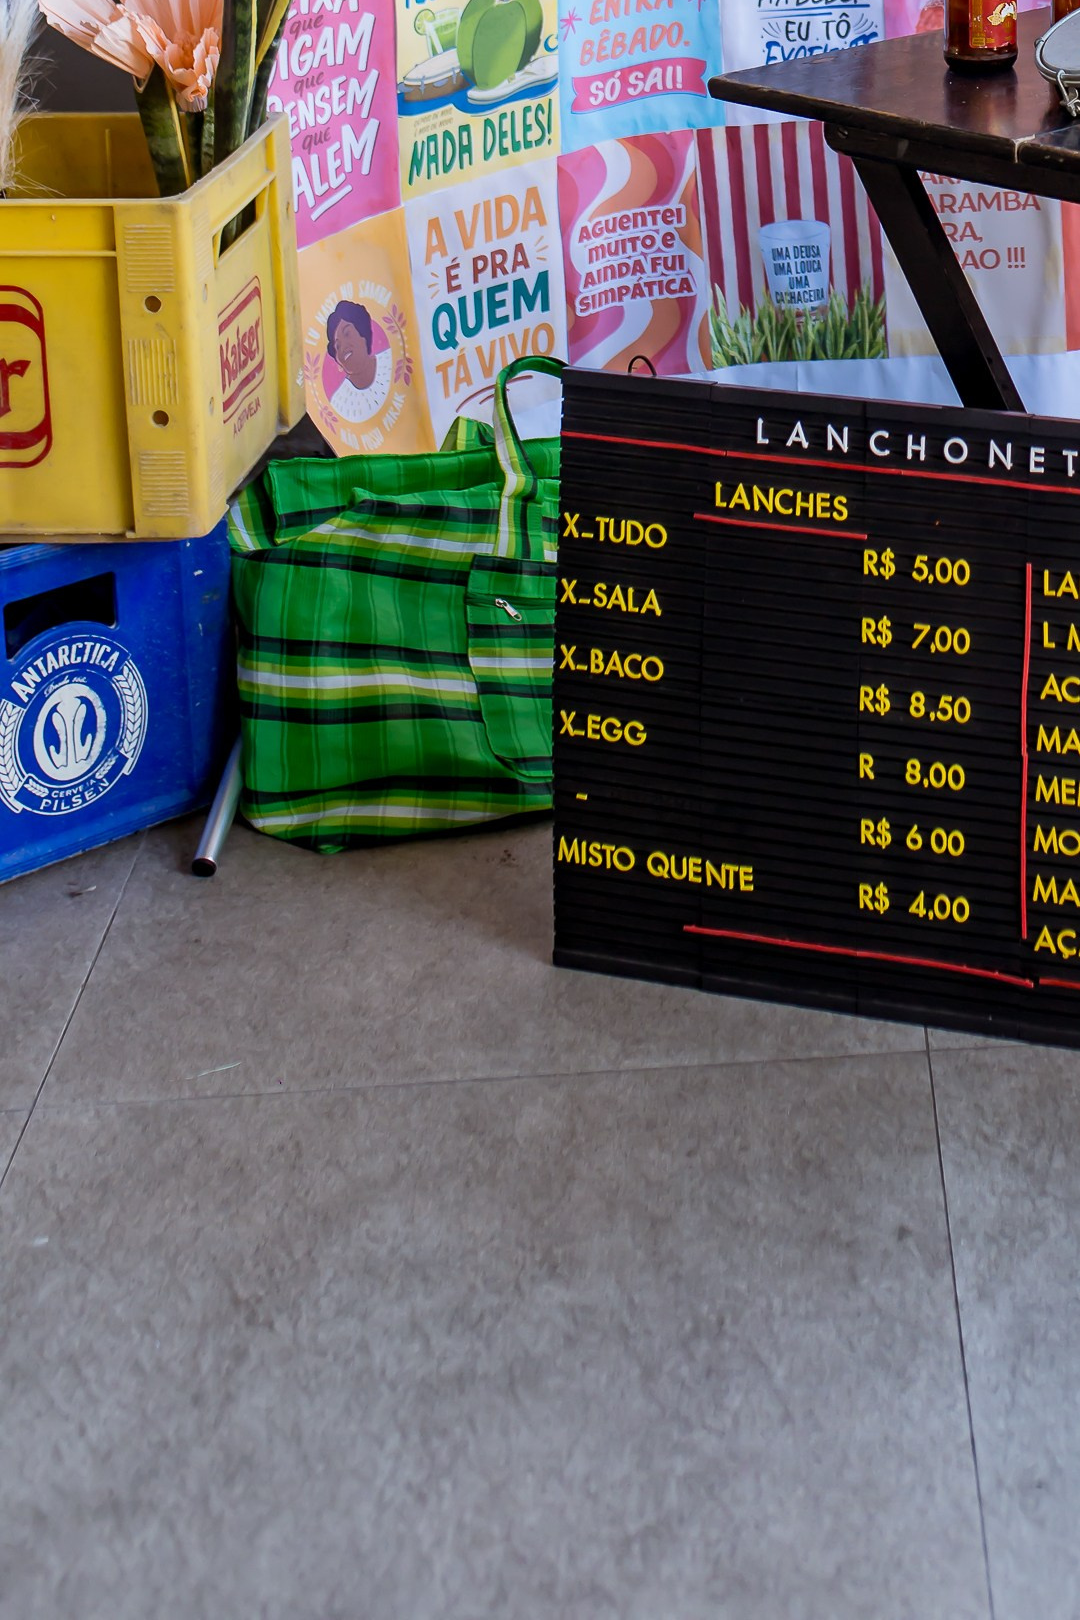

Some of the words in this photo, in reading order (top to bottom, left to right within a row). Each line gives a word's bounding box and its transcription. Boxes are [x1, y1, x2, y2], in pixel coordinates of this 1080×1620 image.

[580, 21, 690, 66] BÊBADO.
[590, 69, 621, 106] SÓ
[629, 64, 682, 96] SAI!
[409, 123, 474, 185] NADA
[484, 98, 552, 152] DELES!
[425, 217, 448, 265] A
[454, 186, 547, 252] VIDA
[446, 258, 461, 294] É
[473, 242, 529, 283] PRA
[772, 246, 791, 261] UMA
[794, 245, 821, 259] DEUSA
[774, 262, 792, 276] UMA
[795, 260, 822, 274] LOUCA
[789, 276, 810, 289] UMA
[432, 270, 550, 351] QUEM
[220, 317, 260, 394] Kaiser
[436, 343, 473, 399] TÁ
[474, 323, 554, 380] VIVO
[715, 482, 848, 521] LANCHES
[863, 548, 895, 579] R$
[912, 555, 970, 586] 5,00
[861, 615, 892, 647] R$
[912, 624, 970, 654] 7,00
[11, 641, 119, 703] ANTARCTICA
[859, 684, 890, 715] R$
[910, 692, 970, 723] 8,50
[859, 754, 874, 779] R
[905, 759, 965, 790] 8,00
[40, 778, 109, 811] PILSEN
[860, 818, 891, 848] R$
[558, 836, 635, 871] MISTO
[647, 852, 753, 891] QUENTE
[859, 883, 889, 913] R$
[909, 891, 969, 923] 4,00
